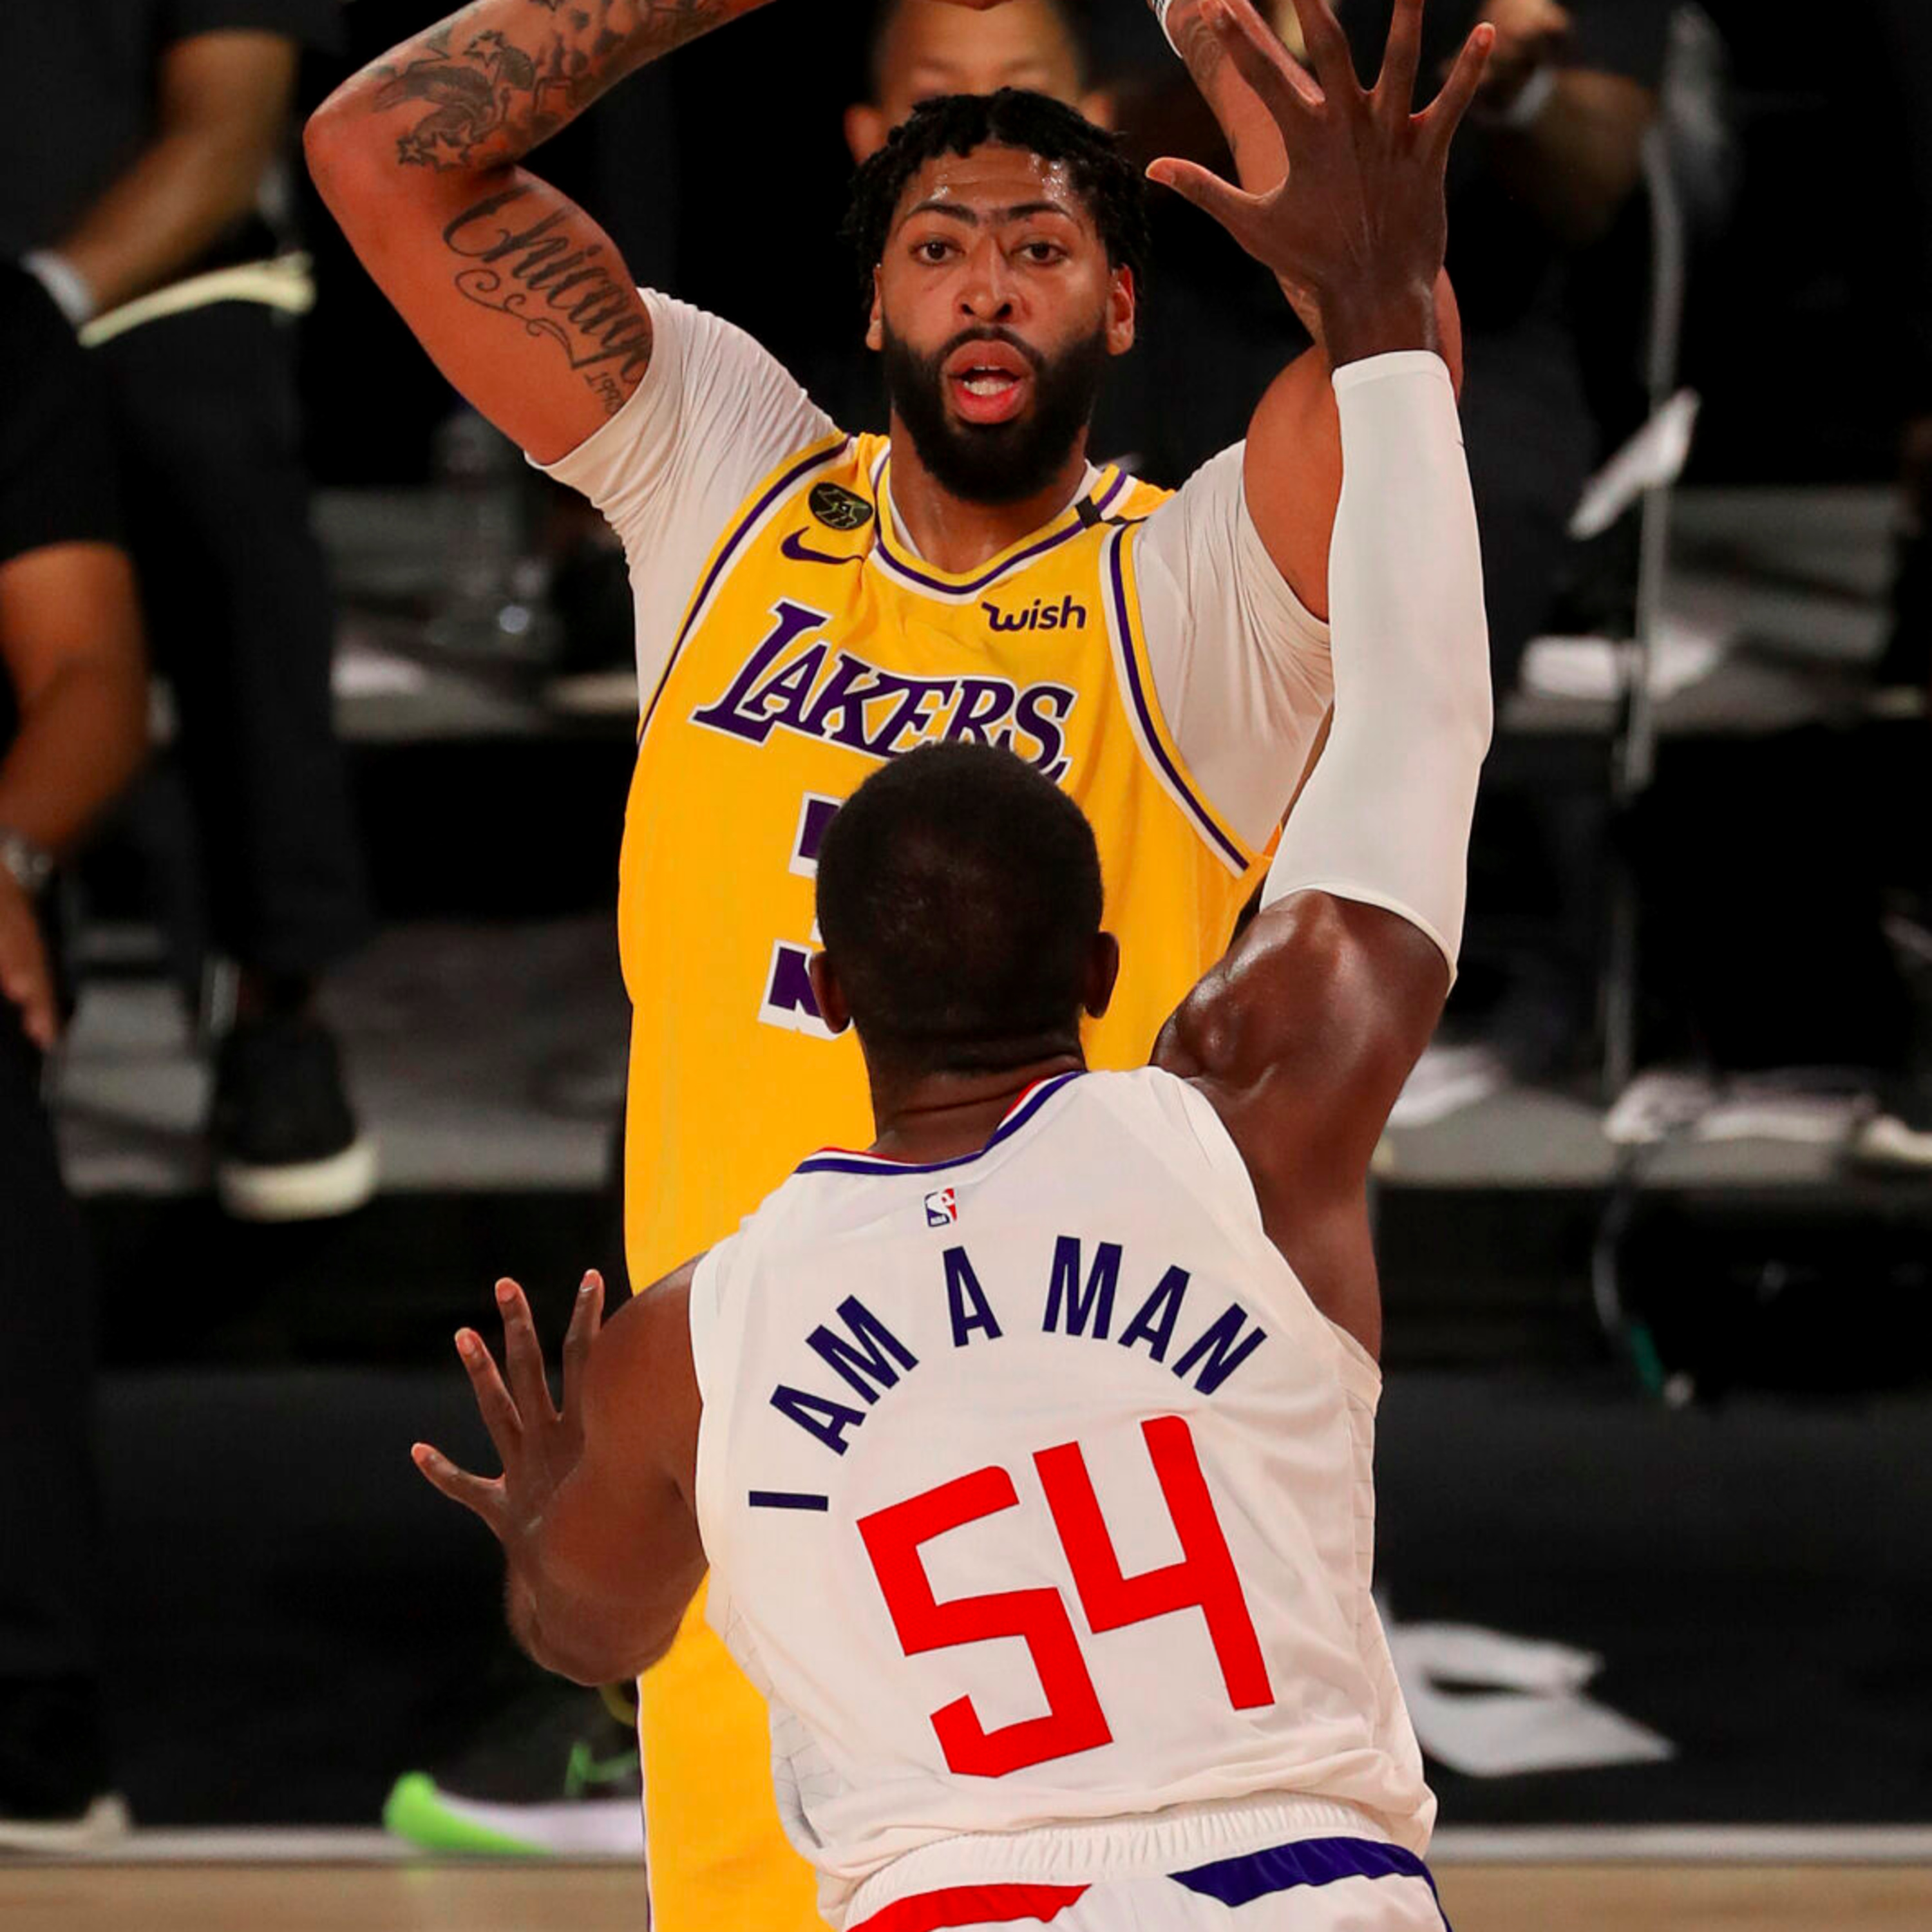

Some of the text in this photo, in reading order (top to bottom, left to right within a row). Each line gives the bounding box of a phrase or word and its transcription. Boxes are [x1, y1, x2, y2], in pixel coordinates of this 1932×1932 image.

[688, 598, 1077, 784] LAKERS
[981, 595, 1086, 632] wish
[749, 1235, 1267, 1511] I AM A MAN
[857, 1415, 1275, 1778] 54
